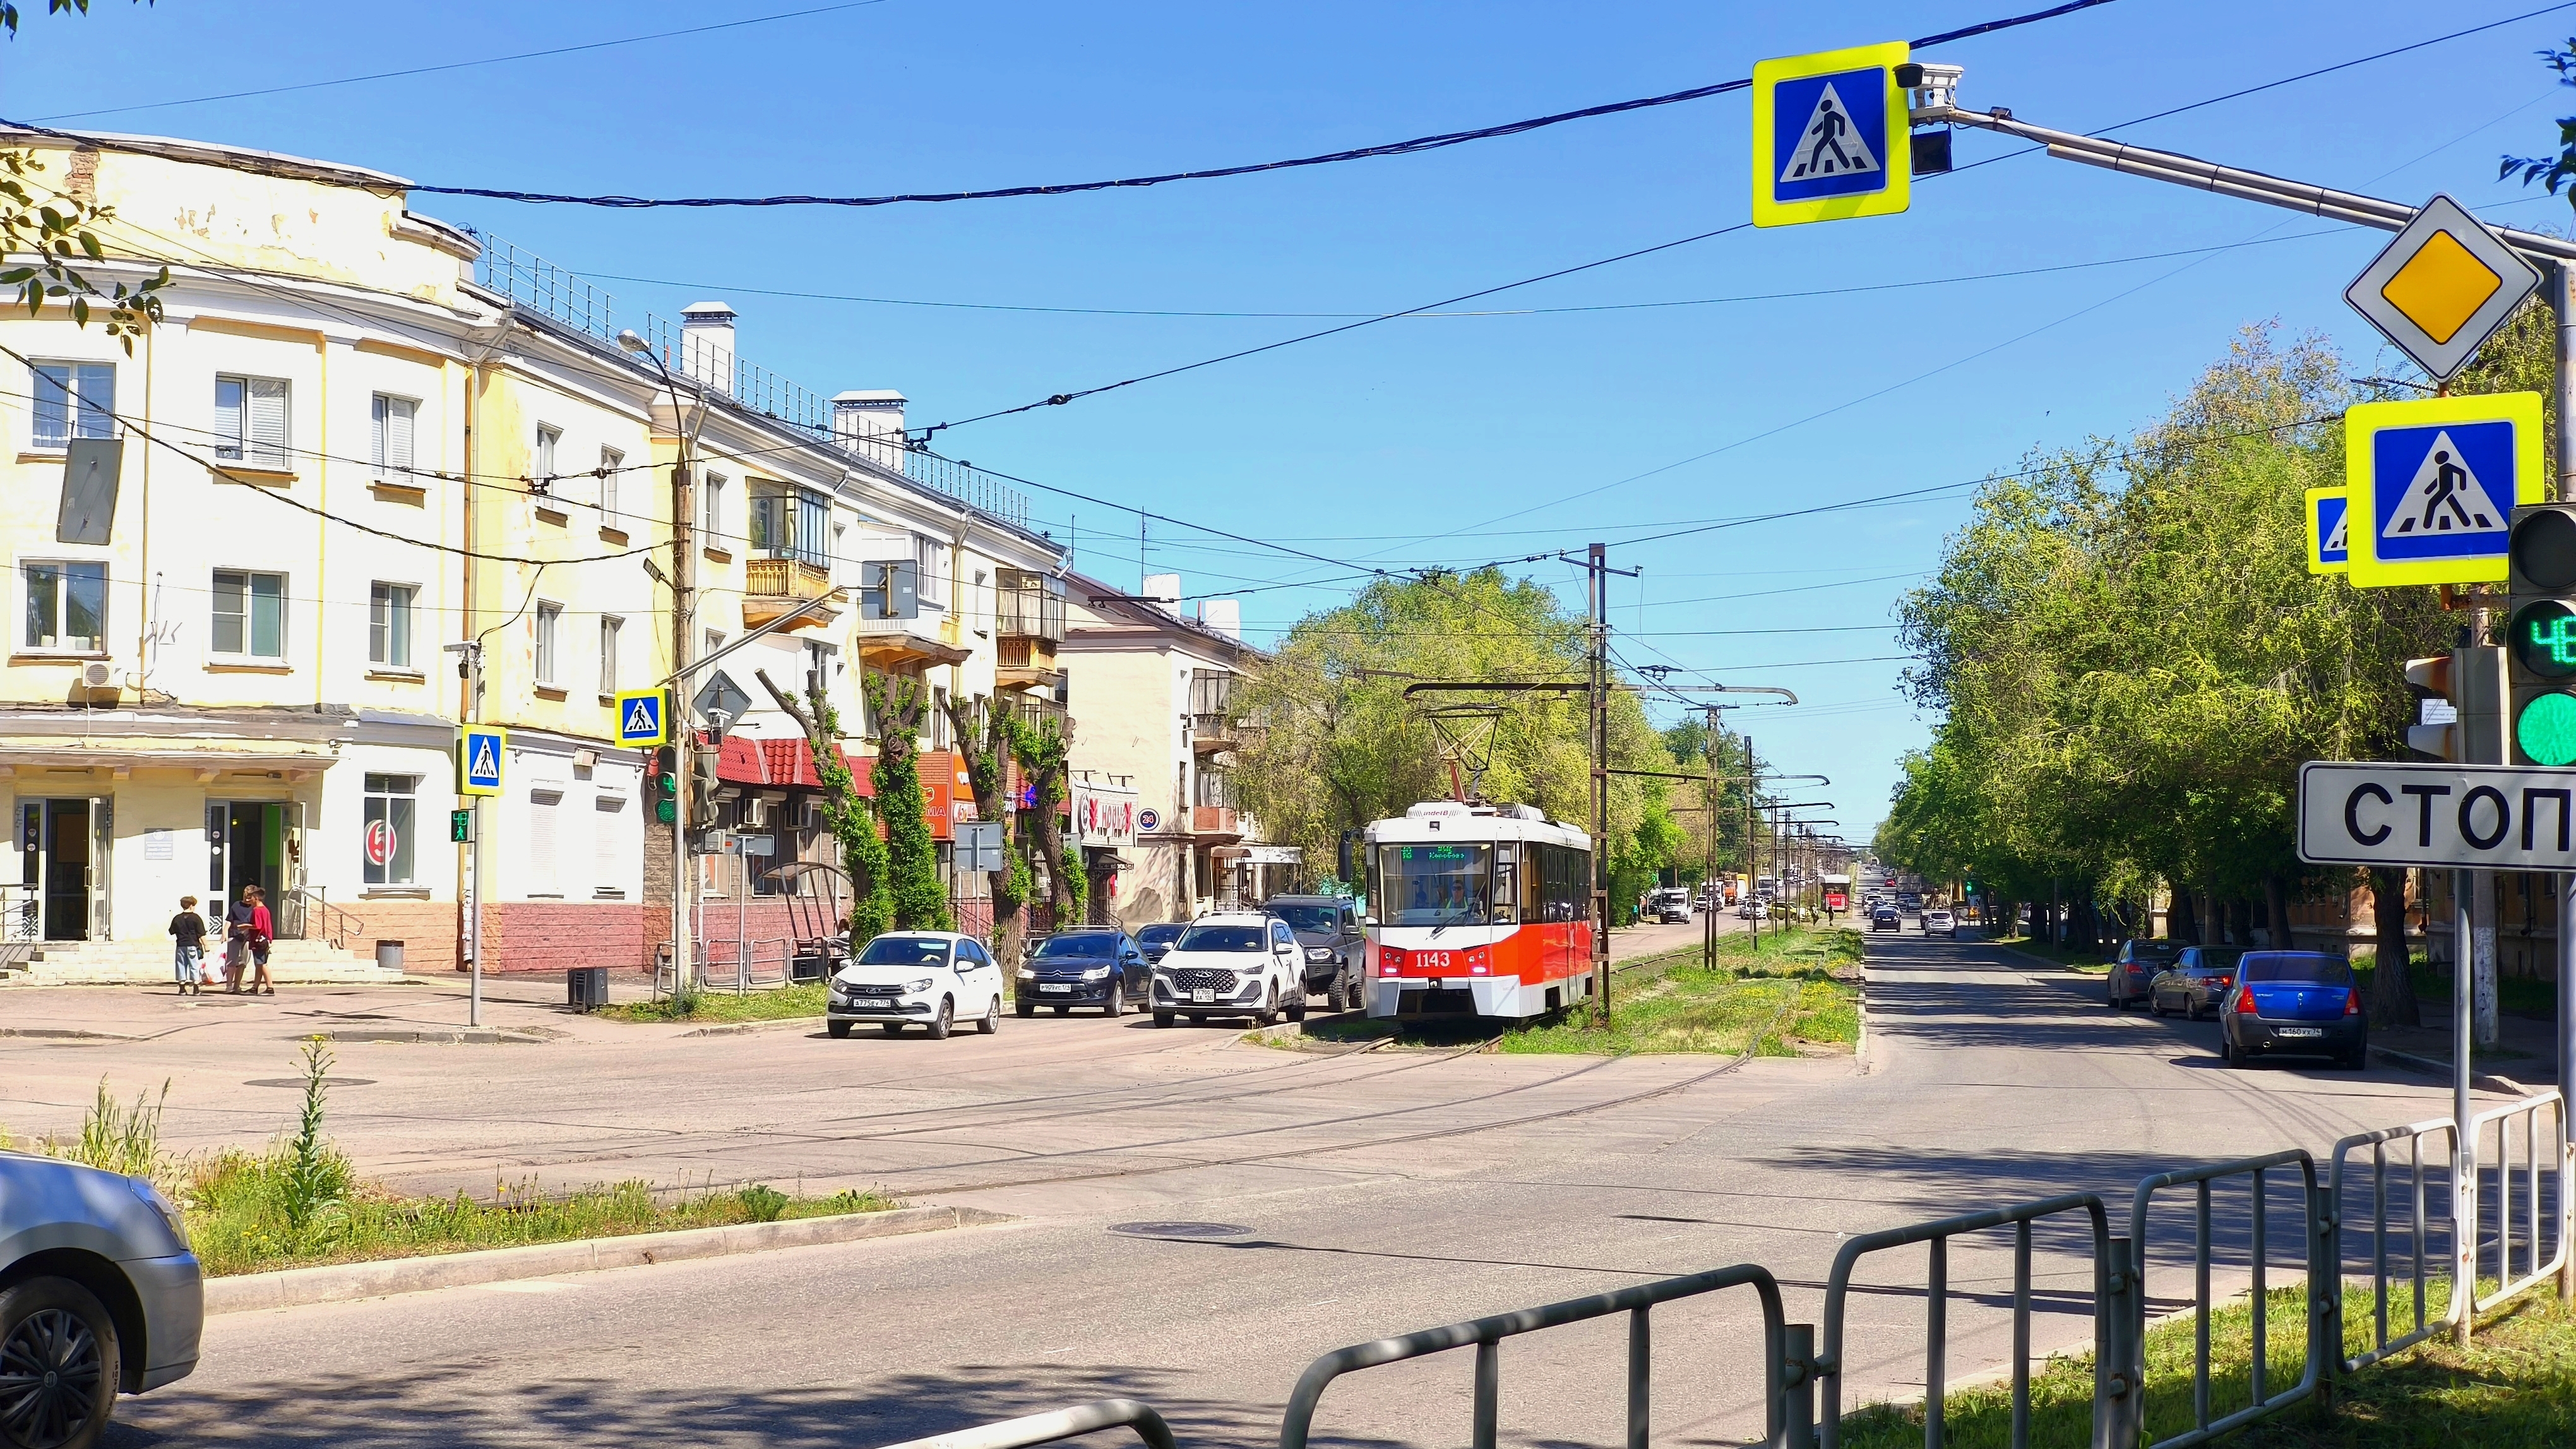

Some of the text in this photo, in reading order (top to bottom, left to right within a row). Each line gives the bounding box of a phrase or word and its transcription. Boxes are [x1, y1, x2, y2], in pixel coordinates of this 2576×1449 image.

[1142, 814, 1154, 824] 24
[2344, 782, 2571, 851] СТОП
[1416, 951, 1450, 967] 1143
